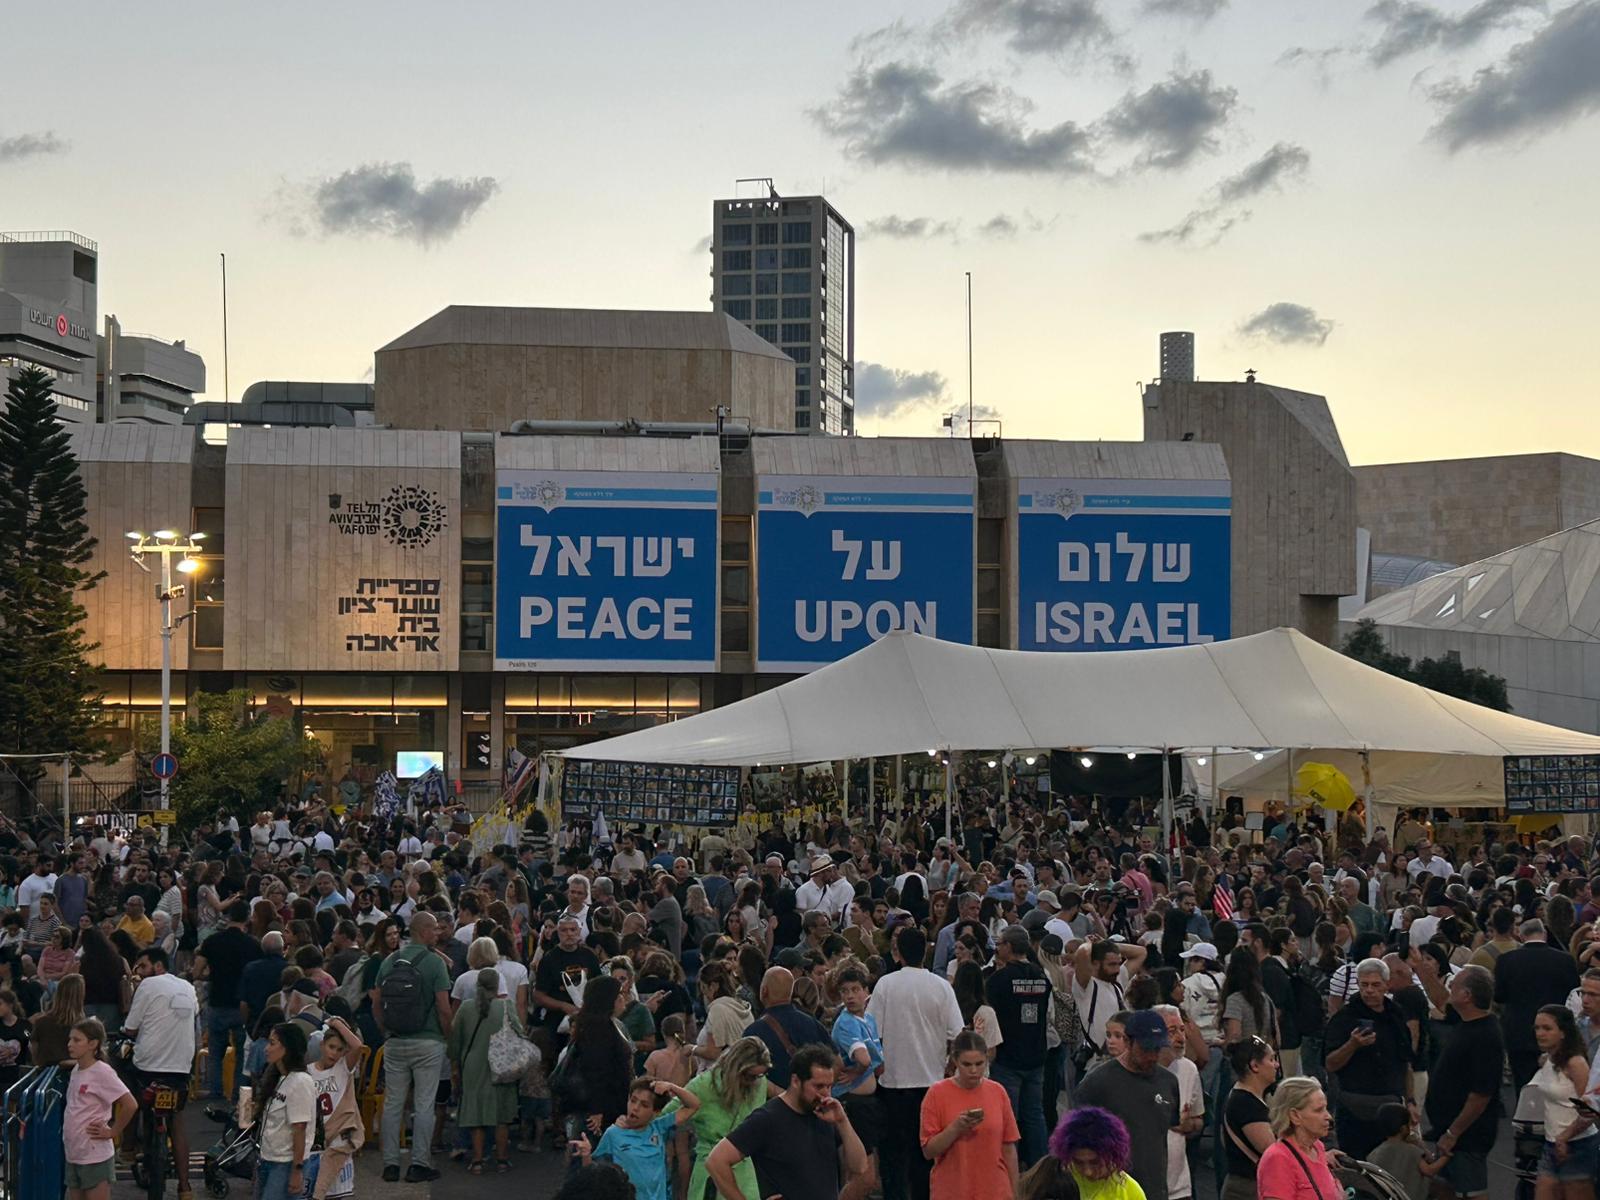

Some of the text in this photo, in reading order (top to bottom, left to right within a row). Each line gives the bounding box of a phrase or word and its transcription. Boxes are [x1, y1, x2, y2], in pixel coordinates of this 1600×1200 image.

[347, 503, 366, 513] TEL
[365, 501, 380, 513] תל
[329, 514, 353, 523] AVIV
[353, 514, 380, 524] אביב
[339, 525, 365, 534] YAFO
[366, 525, 380, 534] יפו
[520, 524, 695, 577] ישראל
[832, 529, 901, 581] על
[1058, 532, 1191, 583] שלום
[356, 578, 440, 595] ספריית
[397, 617, 440, 633] בית
[519, 596, 693, 640] PEACE
[794, 599, 937, 643] UPON
[1035, 601, 1214, 644] ISRAEL
[346, 633, 440, 652] אריאלה
